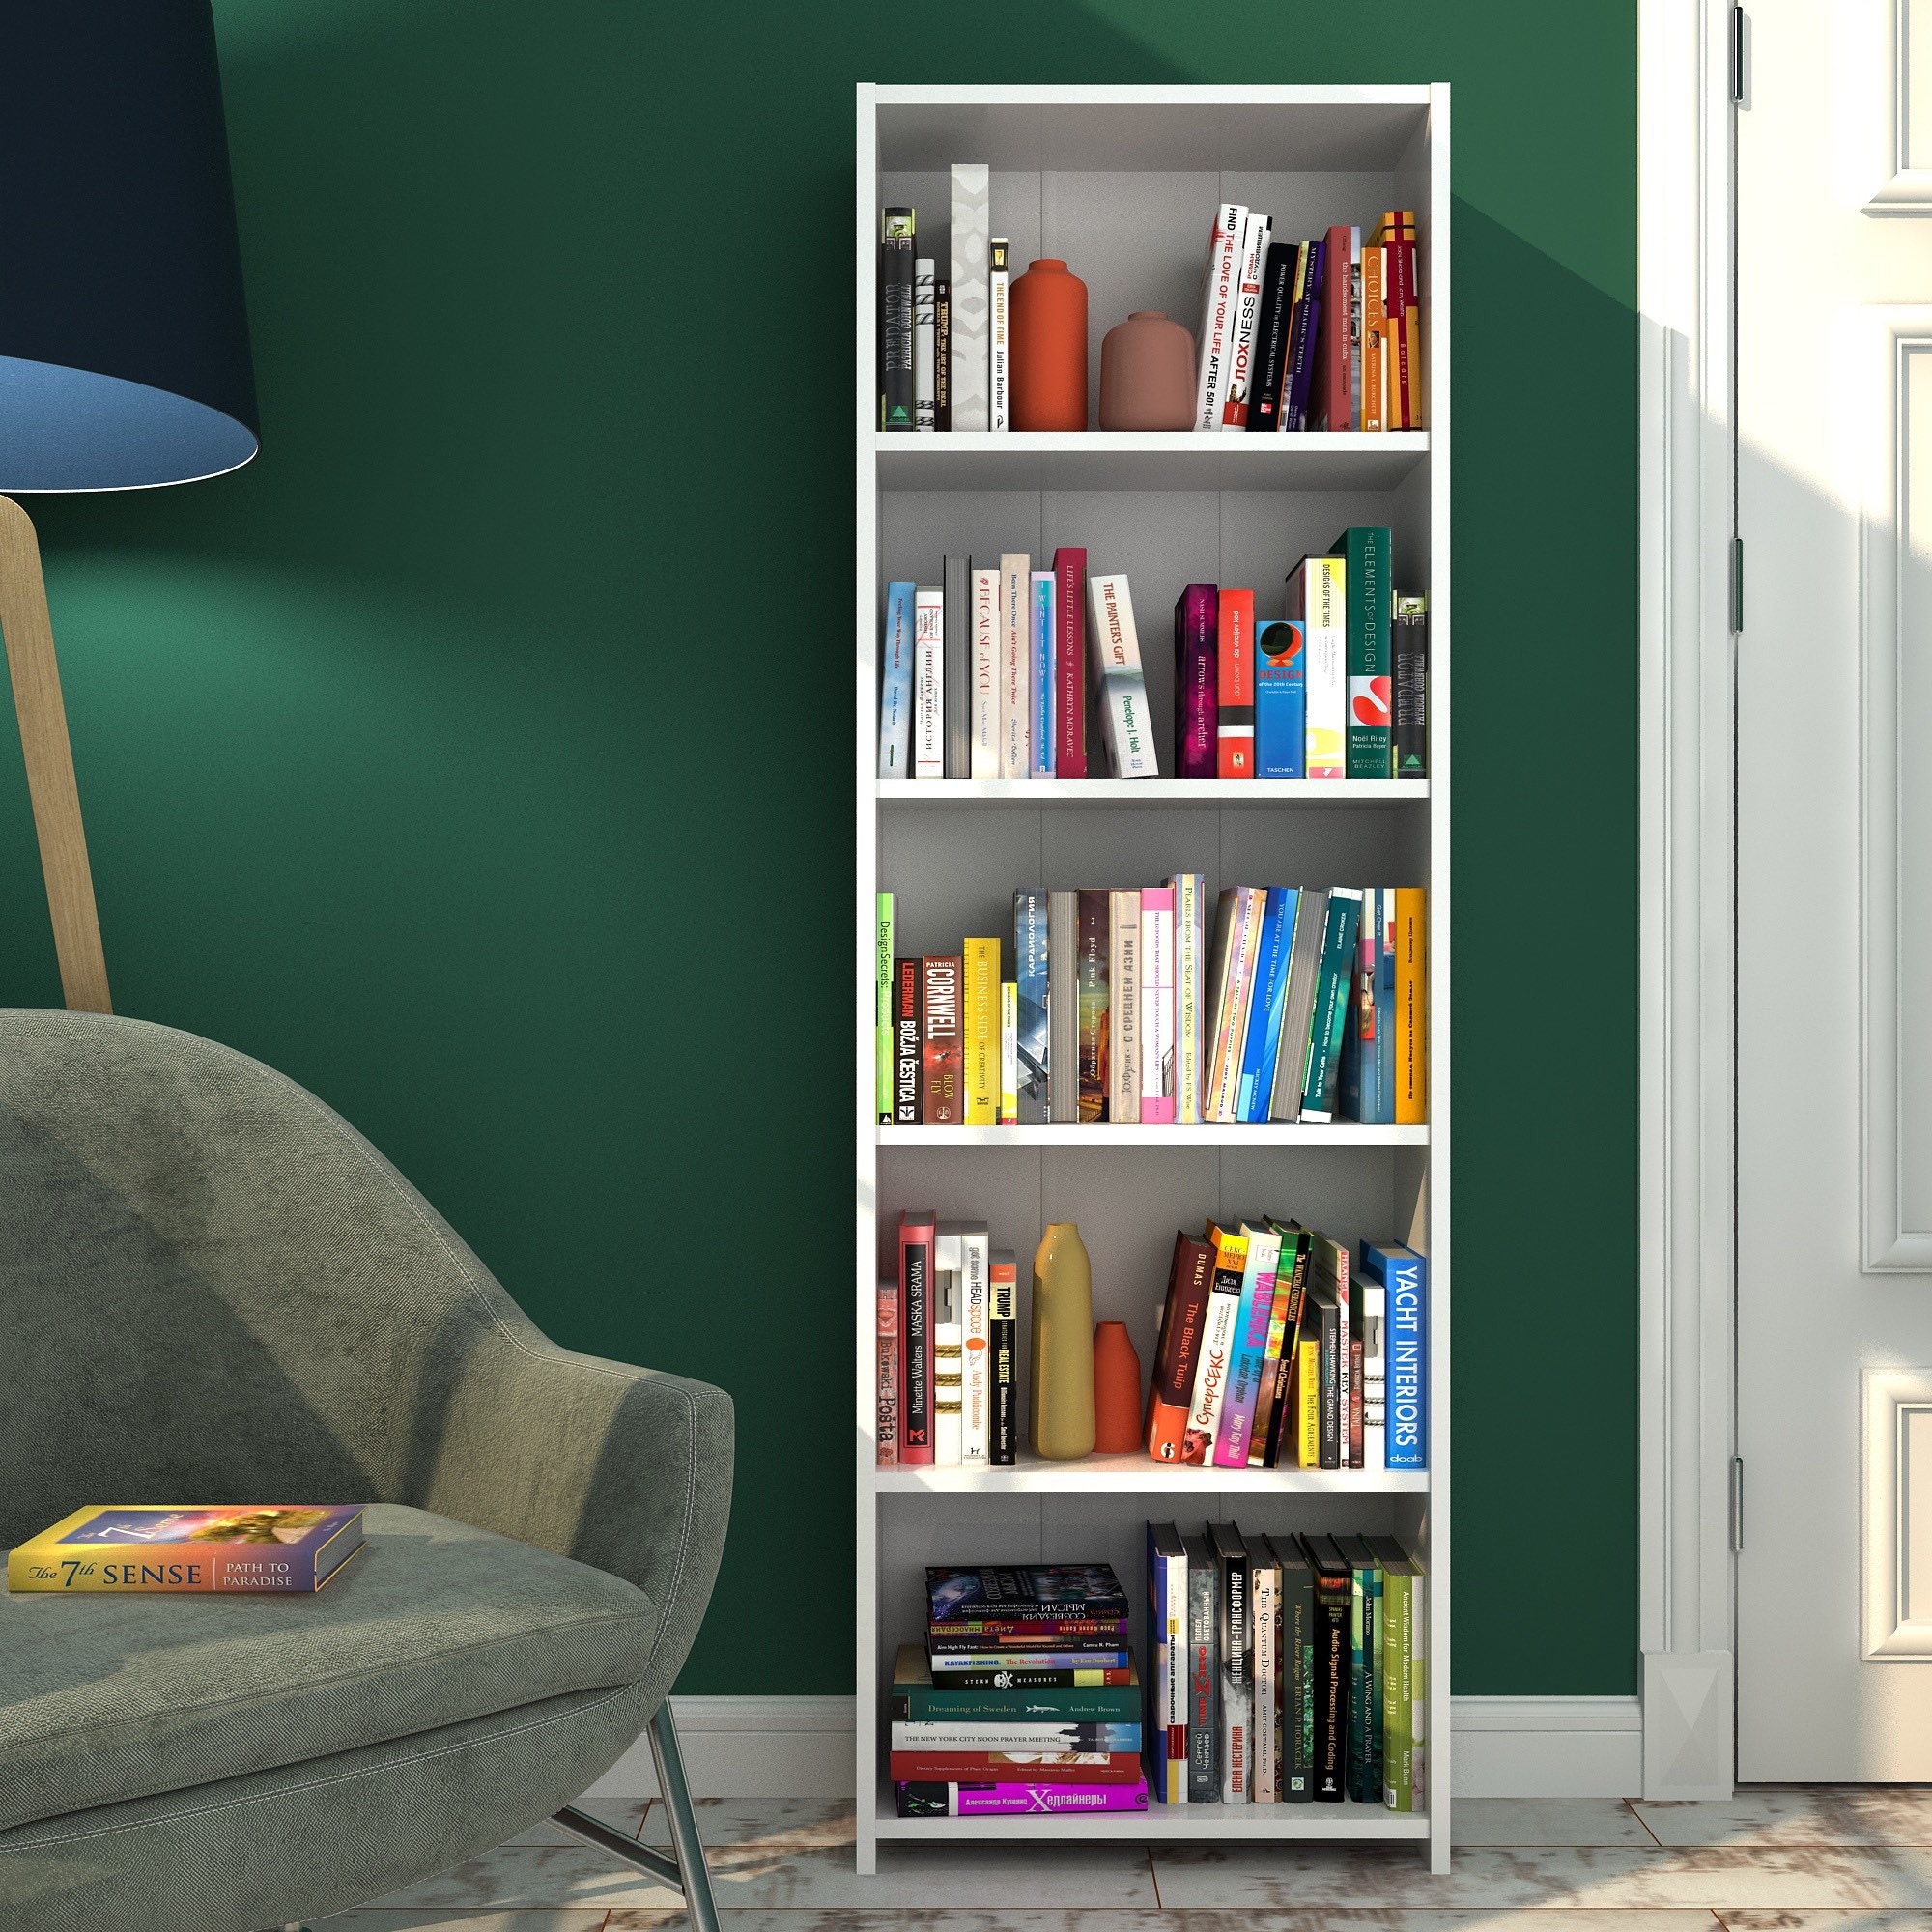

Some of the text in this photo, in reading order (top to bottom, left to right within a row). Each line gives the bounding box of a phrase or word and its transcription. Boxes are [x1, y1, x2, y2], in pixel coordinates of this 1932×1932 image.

[1275, 287, 1284, 315] QUALITY
[1368, 256, 1378, 327] CHOICES
[997, 315, 1004, 325] OF
[1205, 208, 1237, 406] FIND THE LOVE OF YOUR LIFE AFTER 50!
[1269, 322, 1278, 357] ELECTRICAL
[1265, 360, 1274, 387] SYSTEMS
[1322, 564, 1331, 588] DESIGNS
[1364, 546, 1376, 611] ELEMENTS
[1322, 598, 1331, 609] THE
[1103, 583, 1124, 665] THE PAINTER'S GIFT
[1322, 610, 1331, 627] TIMES
[1364, 622, 1376, 672] DESIGN
[1259, 670, 1302, 679] DESIGN
[1196, 656, 1208, 748] arrows through archer
[1122, 696, 1134, 728] Penelope
[1129, 737, 1140, 753] Holt
[1277, 903, 1286, 919] YOU
[1274, 935, 1281, 944] AT
[878, 921, 890, 988] Design Secrets:
[1269, 960, 1278, 977] TIME
[977, 961, 987, 1012] BUSINESS
[927, 968, 956, 1040] CORNWELL
[1264, 994, 1273, 1011] LOVE
[899, 962, 920, 1102] LEDERMAN BOŽJA ČESTICA
[977, 1014, 987, 1040] SIDE
[978, 1042, 985, 1051] OF
[930, 1080, 941, 1094] FLY
[943, 1074, 954, 1099] BLOW
[1193, 1253, 1207, 1286] DUMAS
[997, 1287, 1011, 1318] TRUMP
[911, 1299, 923, 1336] MASKA
[1173, 1303, 1199, 1390] The Black Tulip
[1395, 1265, 1418, 1446] YACHT INTERIORS
[911, 1345, 923, 1378] Walters
[878, 1341, 896, 1442] Bukowski Pošta
[912, 1380, 923, 1414] Minette
[970, 1370, 982, 1430] Andy Puddicombe
[1196, 1349, 1224, 1425] СуперСЕКС
[28, 1560, 202, 1588] The 7th SENSE
[223, 1576, 292, 1586] PARADISE
[226, 1562, 289, 1573] PATH TO
[1231, 1572, 1243, 1684] ЖЕНЩИНА-ТРАНСФОРМЕР
[1331, 1628, 1341, 1652] Audio
[1293, 1659, 1302, 1681] Reigns
[1329, 1654, 1340, 1679] Signal
[928, 1704, 971, 1714] Dreaming
[1326, 1681, 1339, 1723] Processing
[1328, 1724, 1337, 1741] and
[1232, 1726, 1243, 1793] ЕЛЕНА НЕСТЕРИНА
[1325, 1742, 1336, 1770] Coding
[1026, 1789, 1107, 1811] Хедлайнеры
